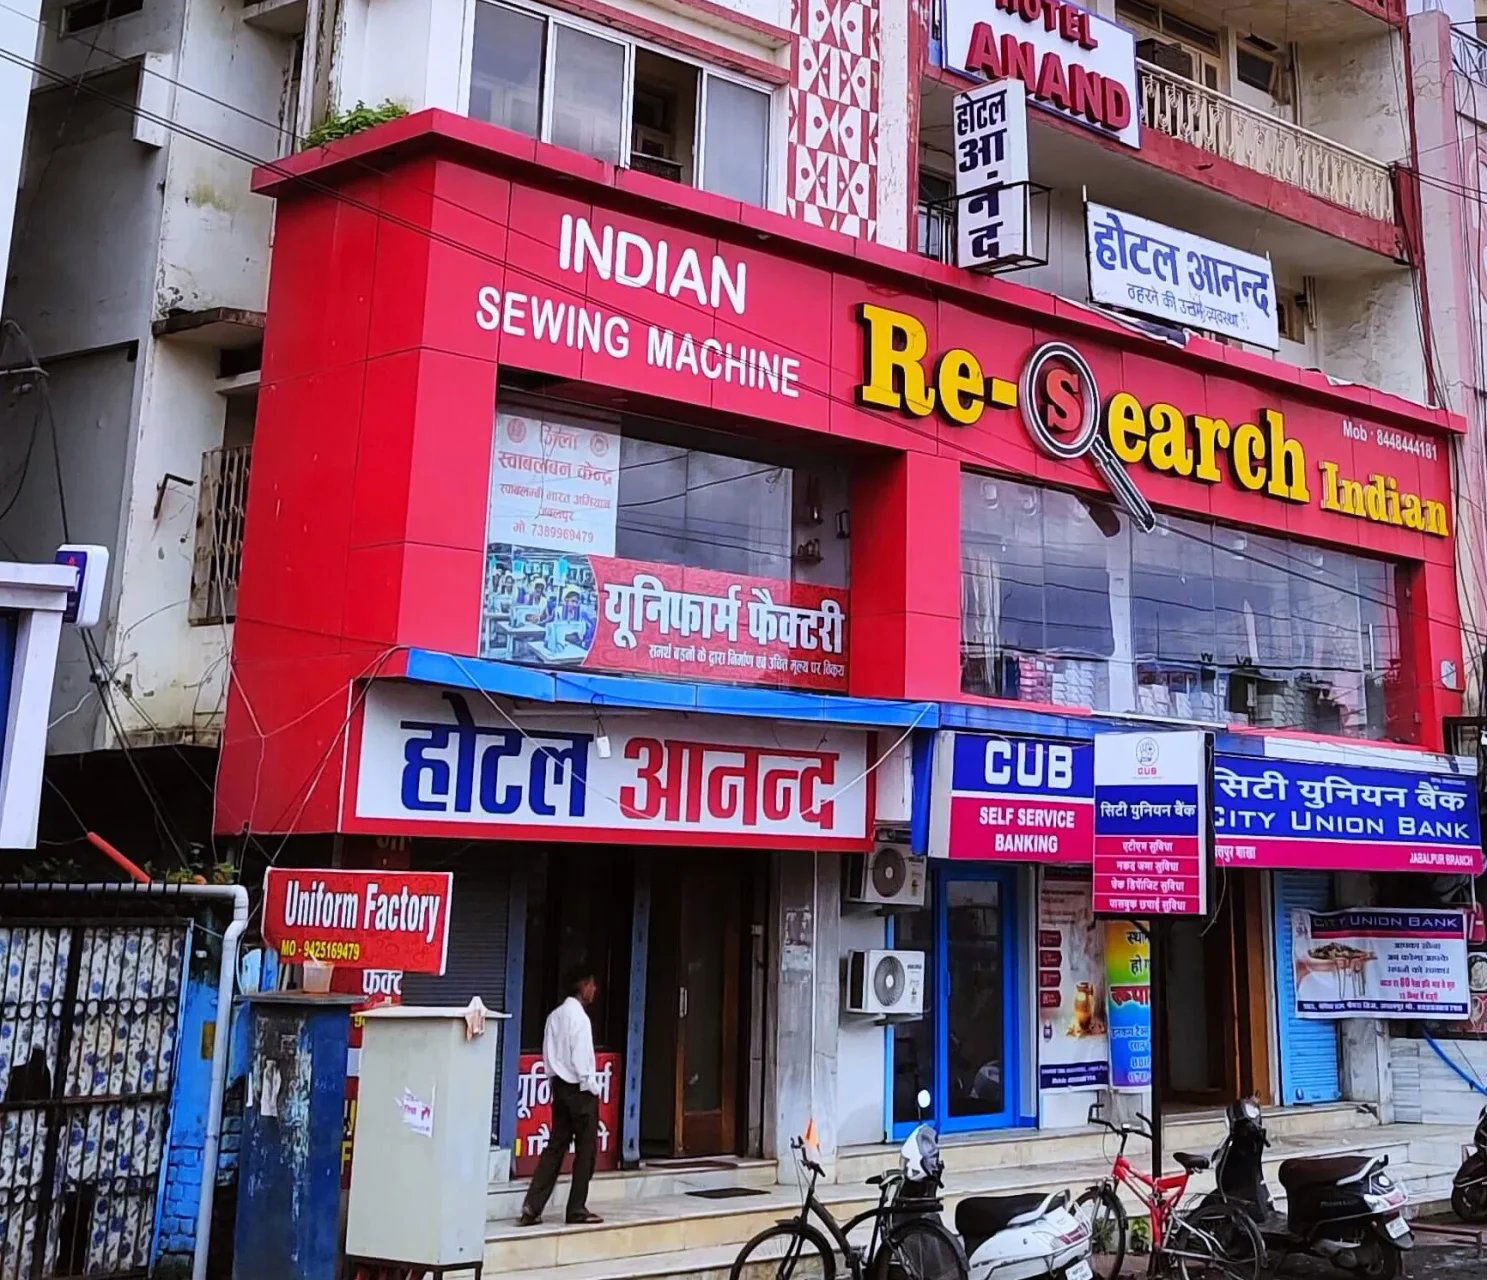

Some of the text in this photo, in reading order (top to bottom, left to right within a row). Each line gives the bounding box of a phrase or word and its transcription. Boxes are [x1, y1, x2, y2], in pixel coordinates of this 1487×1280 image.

[965, 22, 1131, 132] ANAND
[956, 90, 1006, 136] होटल
[558, 214, 746, 314] INDIAN
[1094, 212, 1270, 318] होटल आनन्द
[1162, 290, 1177, 312] की
[475, 286, 800, 398] SEWING MACHINE
[1318, 460, 1449, 537] Indian
[748, 587, 846, 654] फैक्टरी
[400, 691, 839, 830] होटल आनन्द
[985, 740, 1073, 789] CUB
[1137, 767, 1158, 776] CUB
[979, 807, 1075, 828] SELF SERVICE
[1101, 801, 1128, 817] सिटी
[1296, 776, 1408, 808] युनियन
[1414, 781, 1468, 812] बैंक
[995, 834, 1058, 853] BANKING
[1291, 811, 1384, 835] UNION
[1398, 816, 1470, 839] BANK
[285, 880, 441, 944] Uniform Factory
[1350, 915, 1401, 926] UNION
[1408, 916, 1458, 927] BANK
